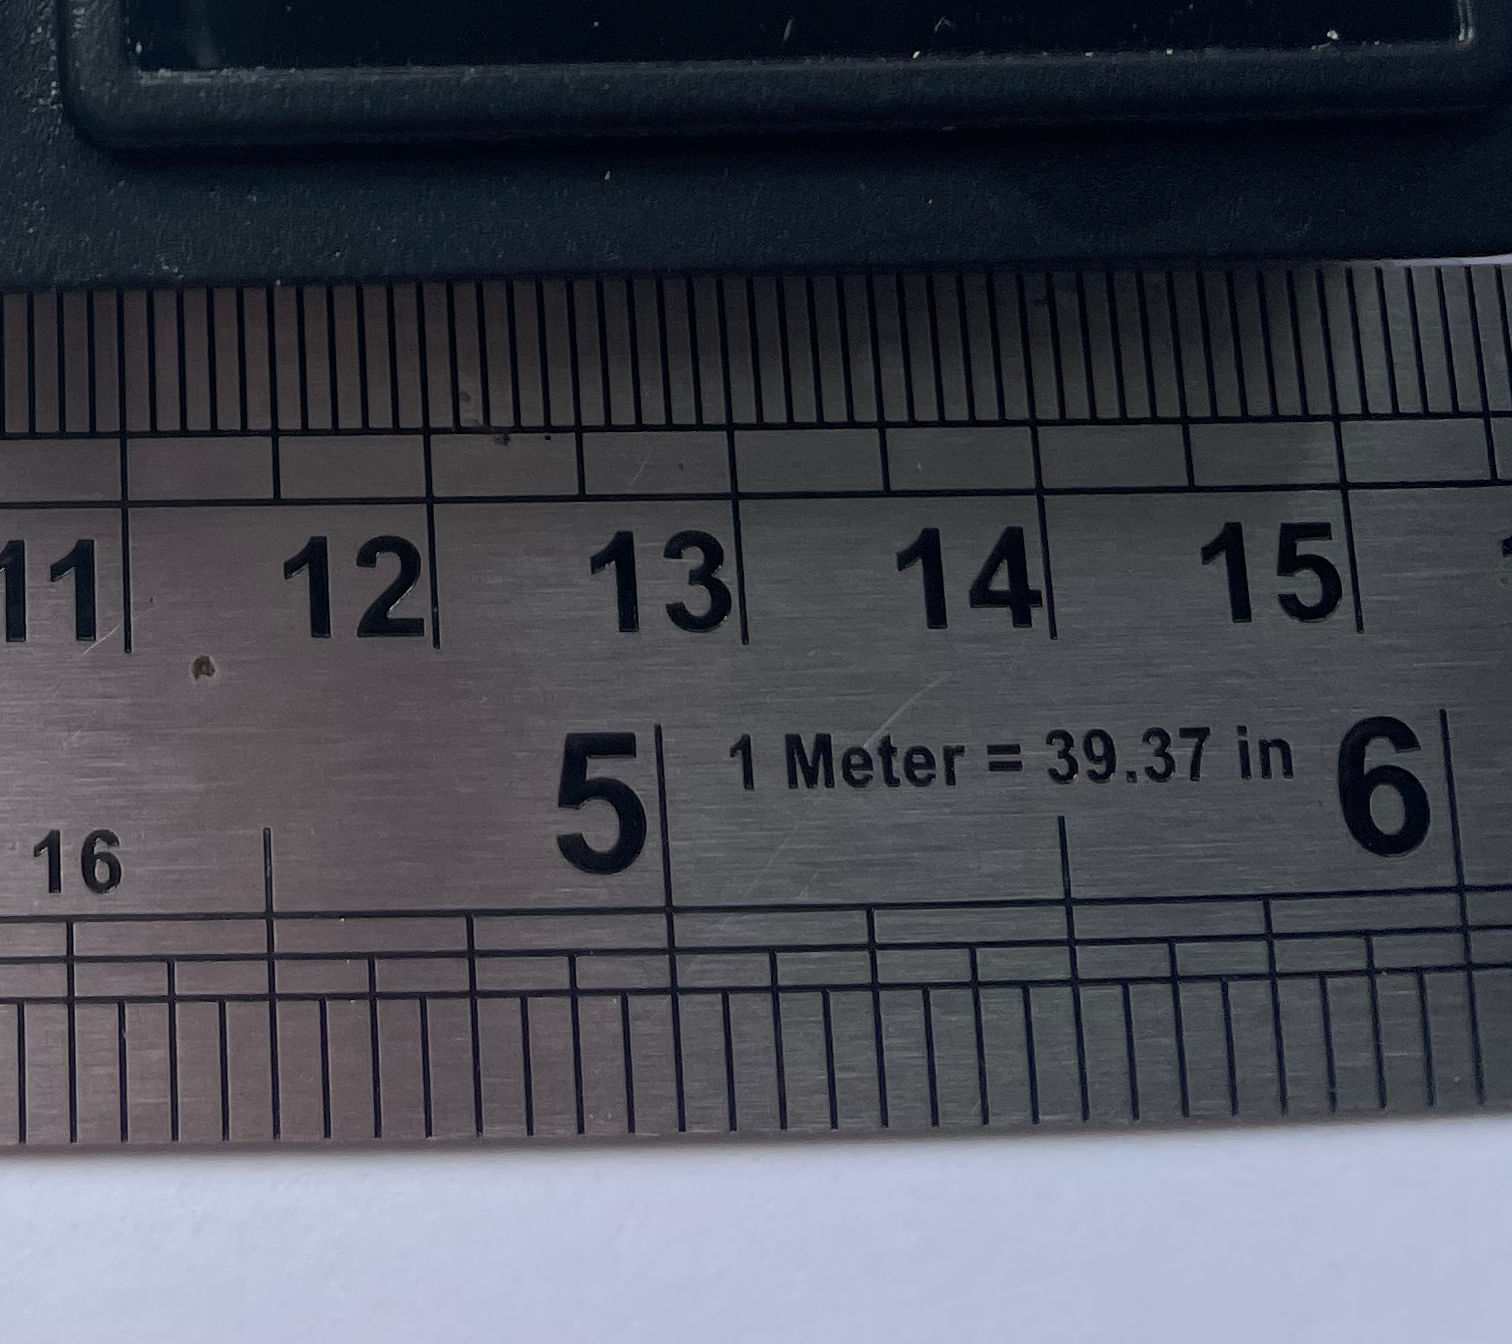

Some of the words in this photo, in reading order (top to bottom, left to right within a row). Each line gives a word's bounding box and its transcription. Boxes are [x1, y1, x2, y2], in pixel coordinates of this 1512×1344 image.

[282, 535, 426, 640] 12
[588, 529, 733, 634] 13
[895, 525, 1044, 630] 14
[1199, 521, 1343, 624] 15
[555, 731, 648, 876] 5
[729, 733, 756, 791] 1
[785, 731, 965, 790] Meter
[1044, 726, 1208, 786] 39.37
[1236, 724, 1295, 780] in
[1336, 715, 1432, 859] 6
[32, 828, 123, 895] 16
